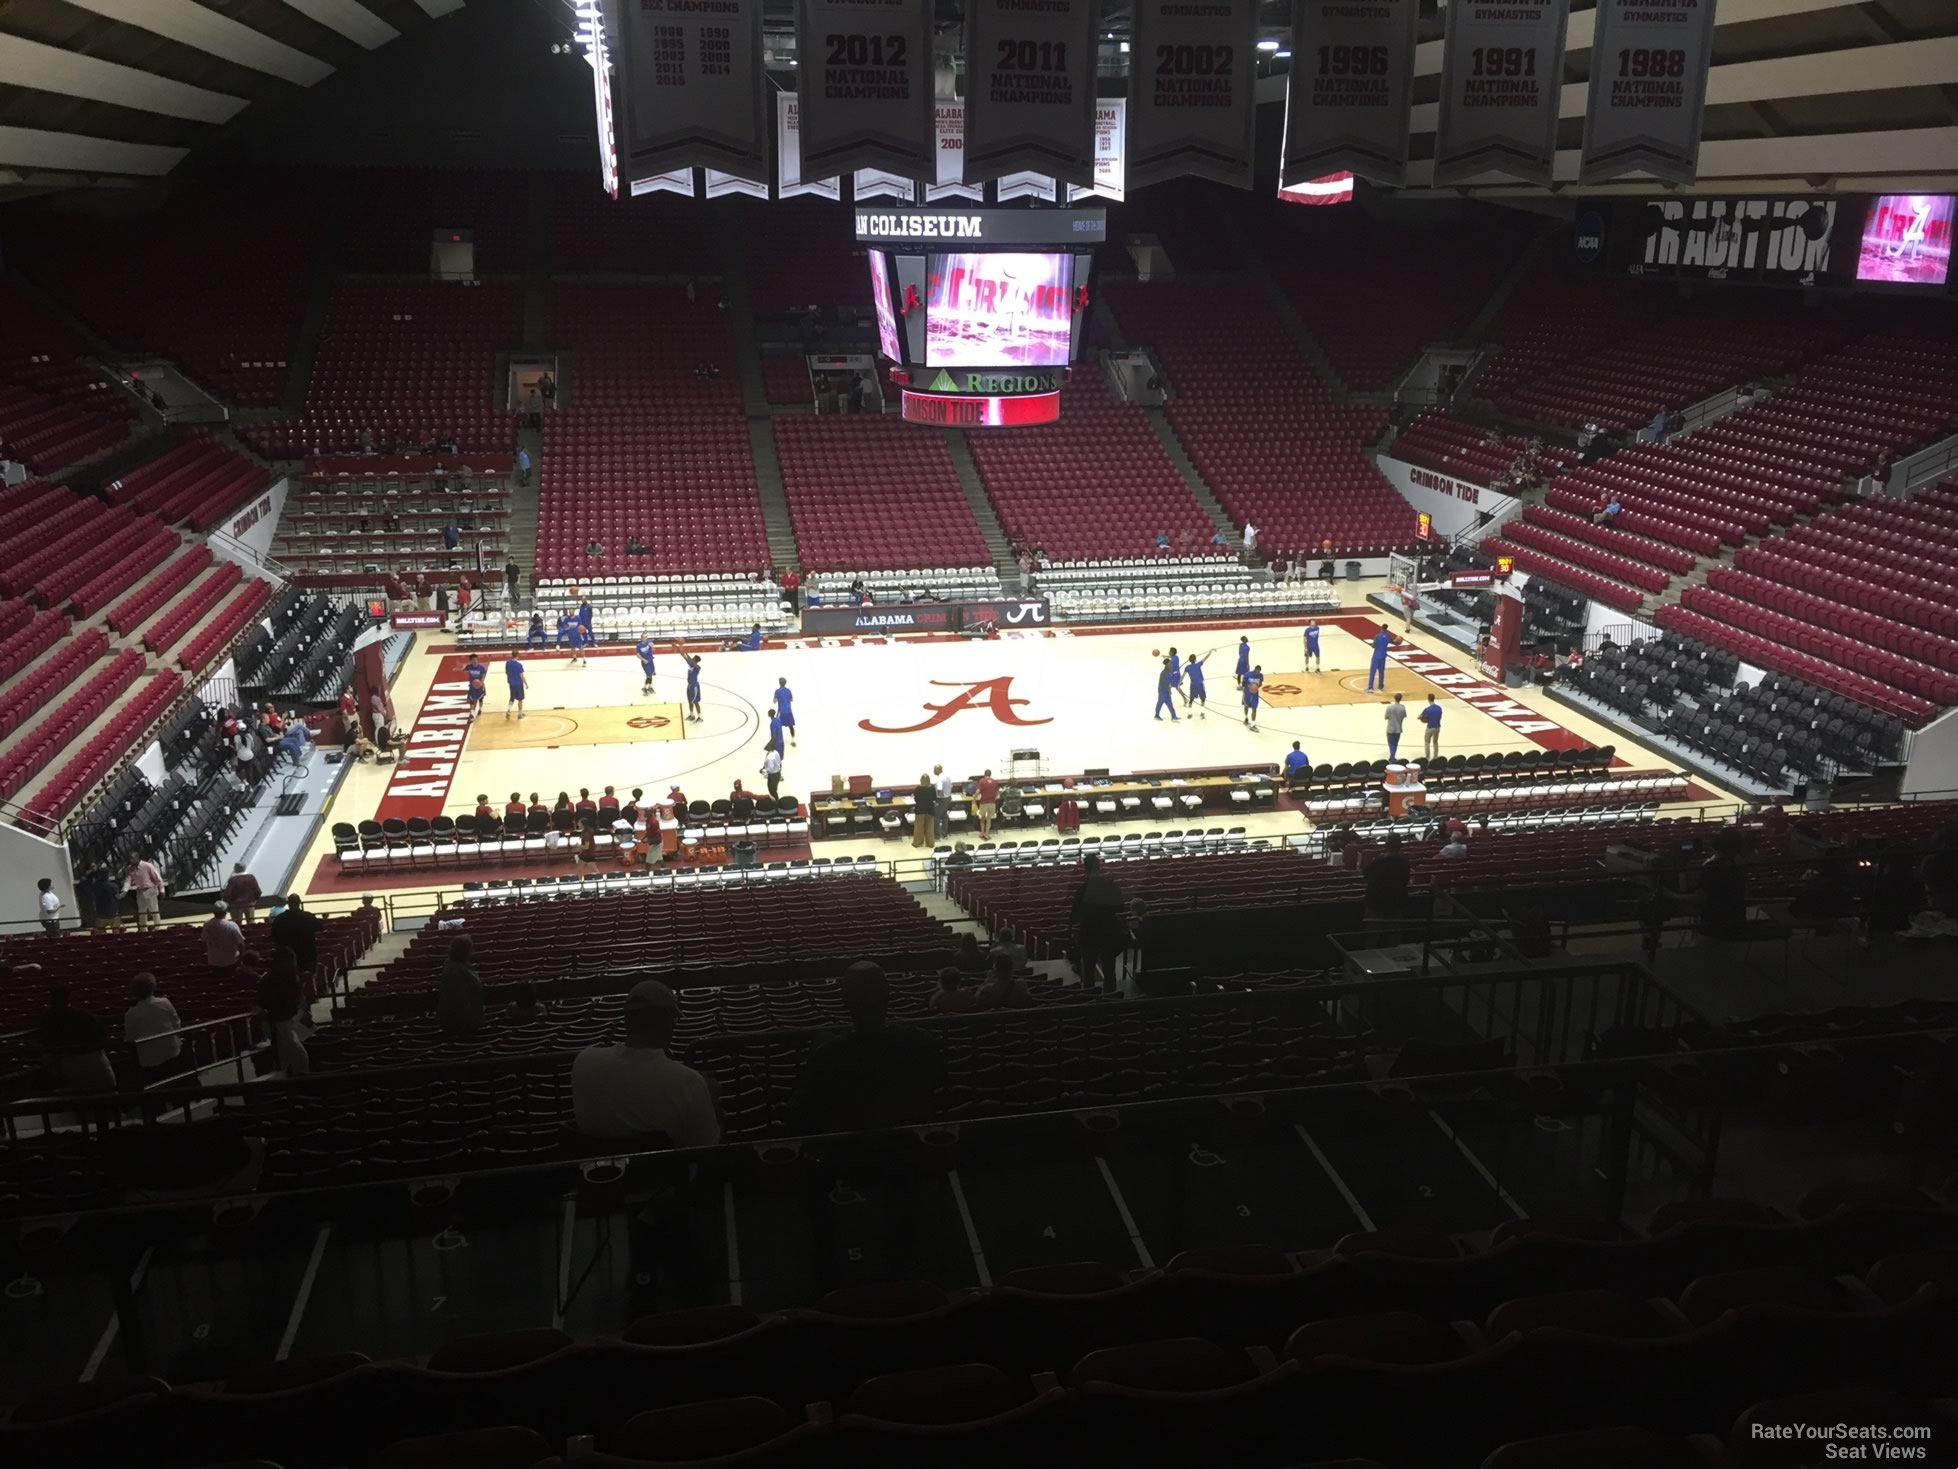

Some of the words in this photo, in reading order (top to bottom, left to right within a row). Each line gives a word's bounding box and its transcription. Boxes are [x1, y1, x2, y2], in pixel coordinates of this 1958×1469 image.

[667, 0, 740, 13] CHAMPIONS
[1160, 5, 1232, 16] GYMNASTICS
[1321, 7, 1391, 17] GYMNASTICS
[1475, 9, 1542, 20] GYMNASTICS
[1624, 11, 1688, 22] GYMNASTICS
[826, 34, 906, 66] 2012
[997, 40, 1066, 72] 2011
[1156, 45, 1233, 75] 2002
[1318, 46, 1388, 75] 1996
[1472, 48, 1536, 76] 1991
[1618, 49, 1685, 77] 1988
[656, 63, 684, 73] 2011
[825, 70, 909, 84] NATIONAL
[991, 74, 1072, 89] NATIONAL
[1155, 79, 1232, 92] NATIONAL
[1313, 79, 1389, 92] NATIONAL
[1465, 80, 1539, 93] NATIONAL
[1612, 80, 1683, 93] NATIONAL
[825, 86, 909, 99] CHAMPIONS
[990, 89, 1072, 104] CHAMPIONS
[1154, 94, 1232, 106] CHAMPIONS
[1312, 93, 1388, 106] CHAMPIONS
[1463, 94, 1538, 107] CHAMPIONS
[1610, 95, 1682, 108] CHAMPIONS
[941, 138, 963, 150] 200
[870, 215, 983, 238] COLISEUM
[1644, 200, 1837, 272] TRADITION
[966, 374, 1057, 393] REGIONS
[951, 401, 984, 425] TIDE
[1410, 468, 1453, 496] CRIMSON
[1456, 483, 1480, 505] TIDE
[855, 614, 914, 627] ALABAMA
